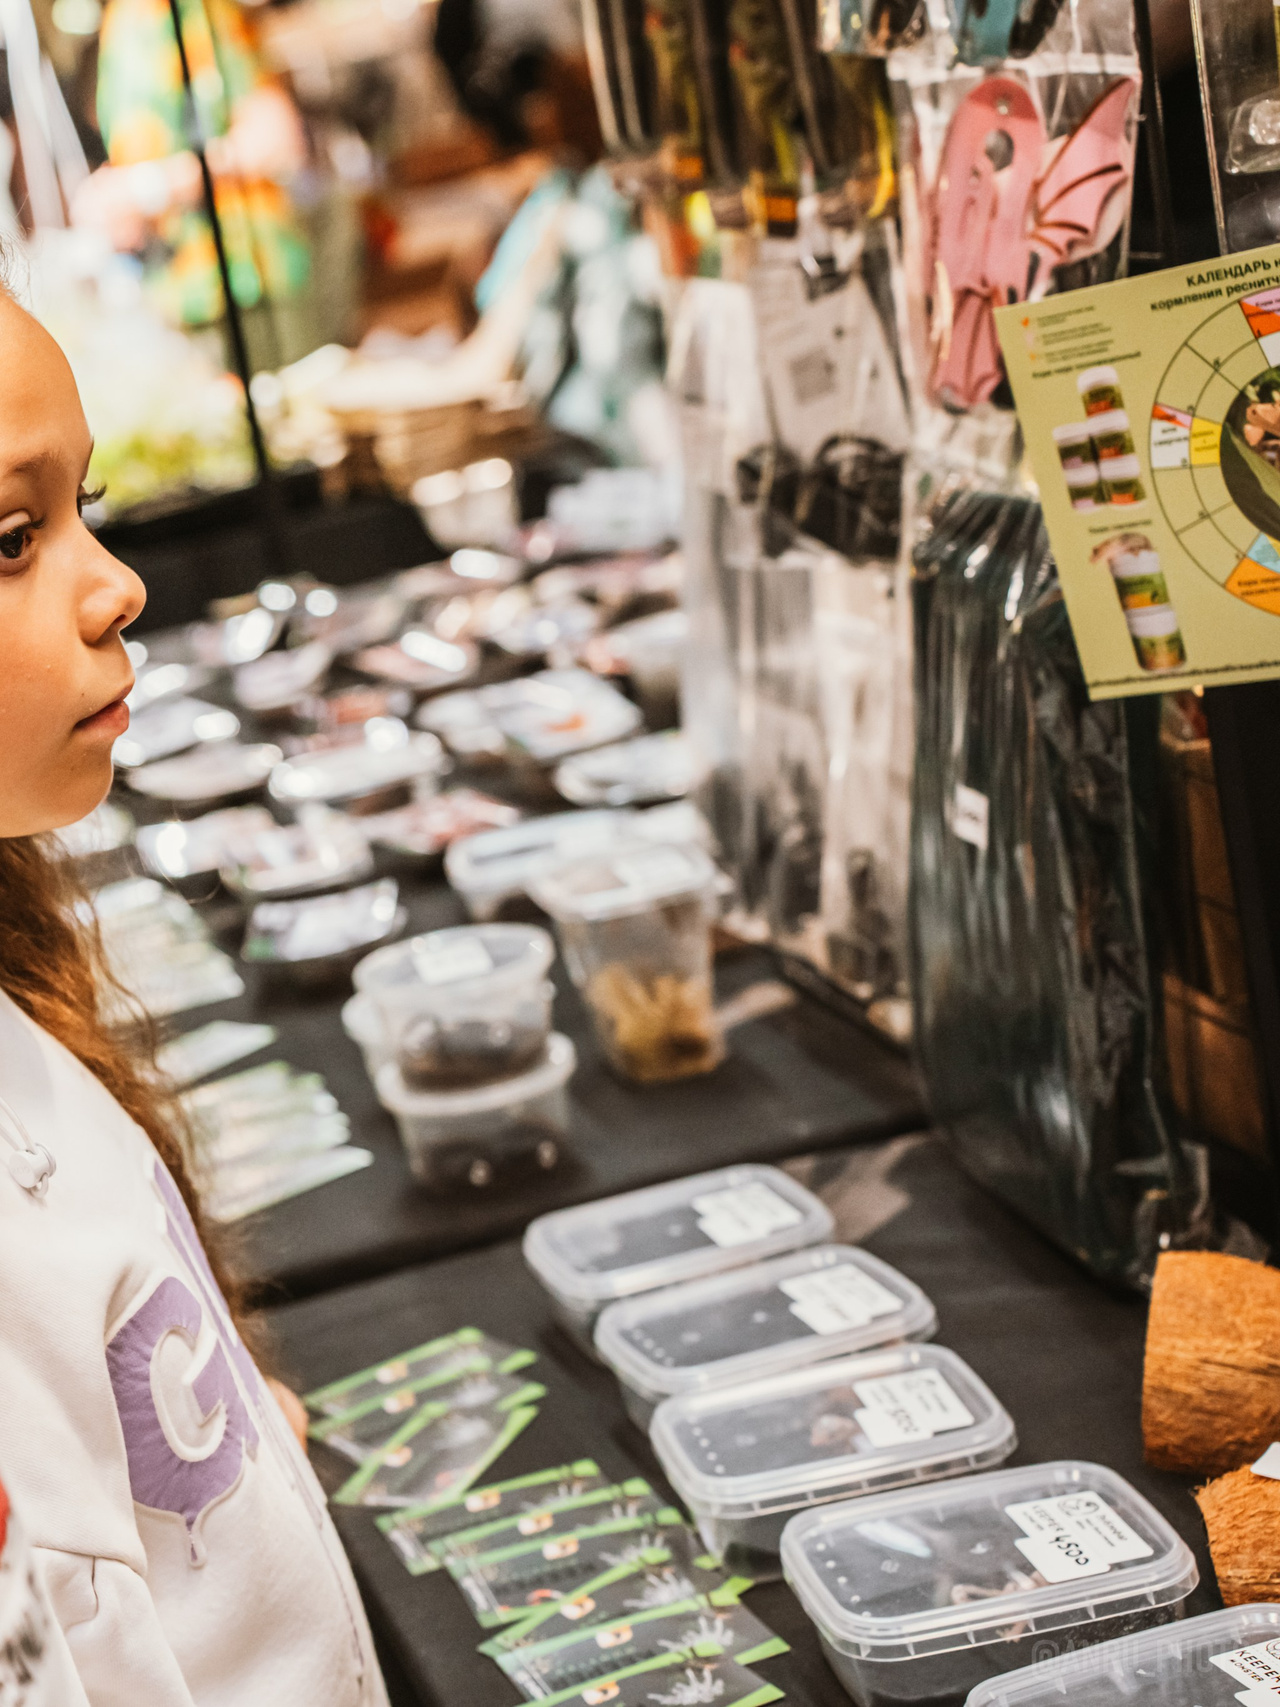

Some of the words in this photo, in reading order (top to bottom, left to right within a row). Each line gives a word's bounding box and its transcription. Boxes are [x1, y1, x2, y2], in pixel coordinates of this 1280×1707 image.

[1186, 259, 1271, 287] КАЛЕНДАРЬ
[1150, 288, 1223, 311] кормления
[1048, 1534, 1089, 1565] 4500
